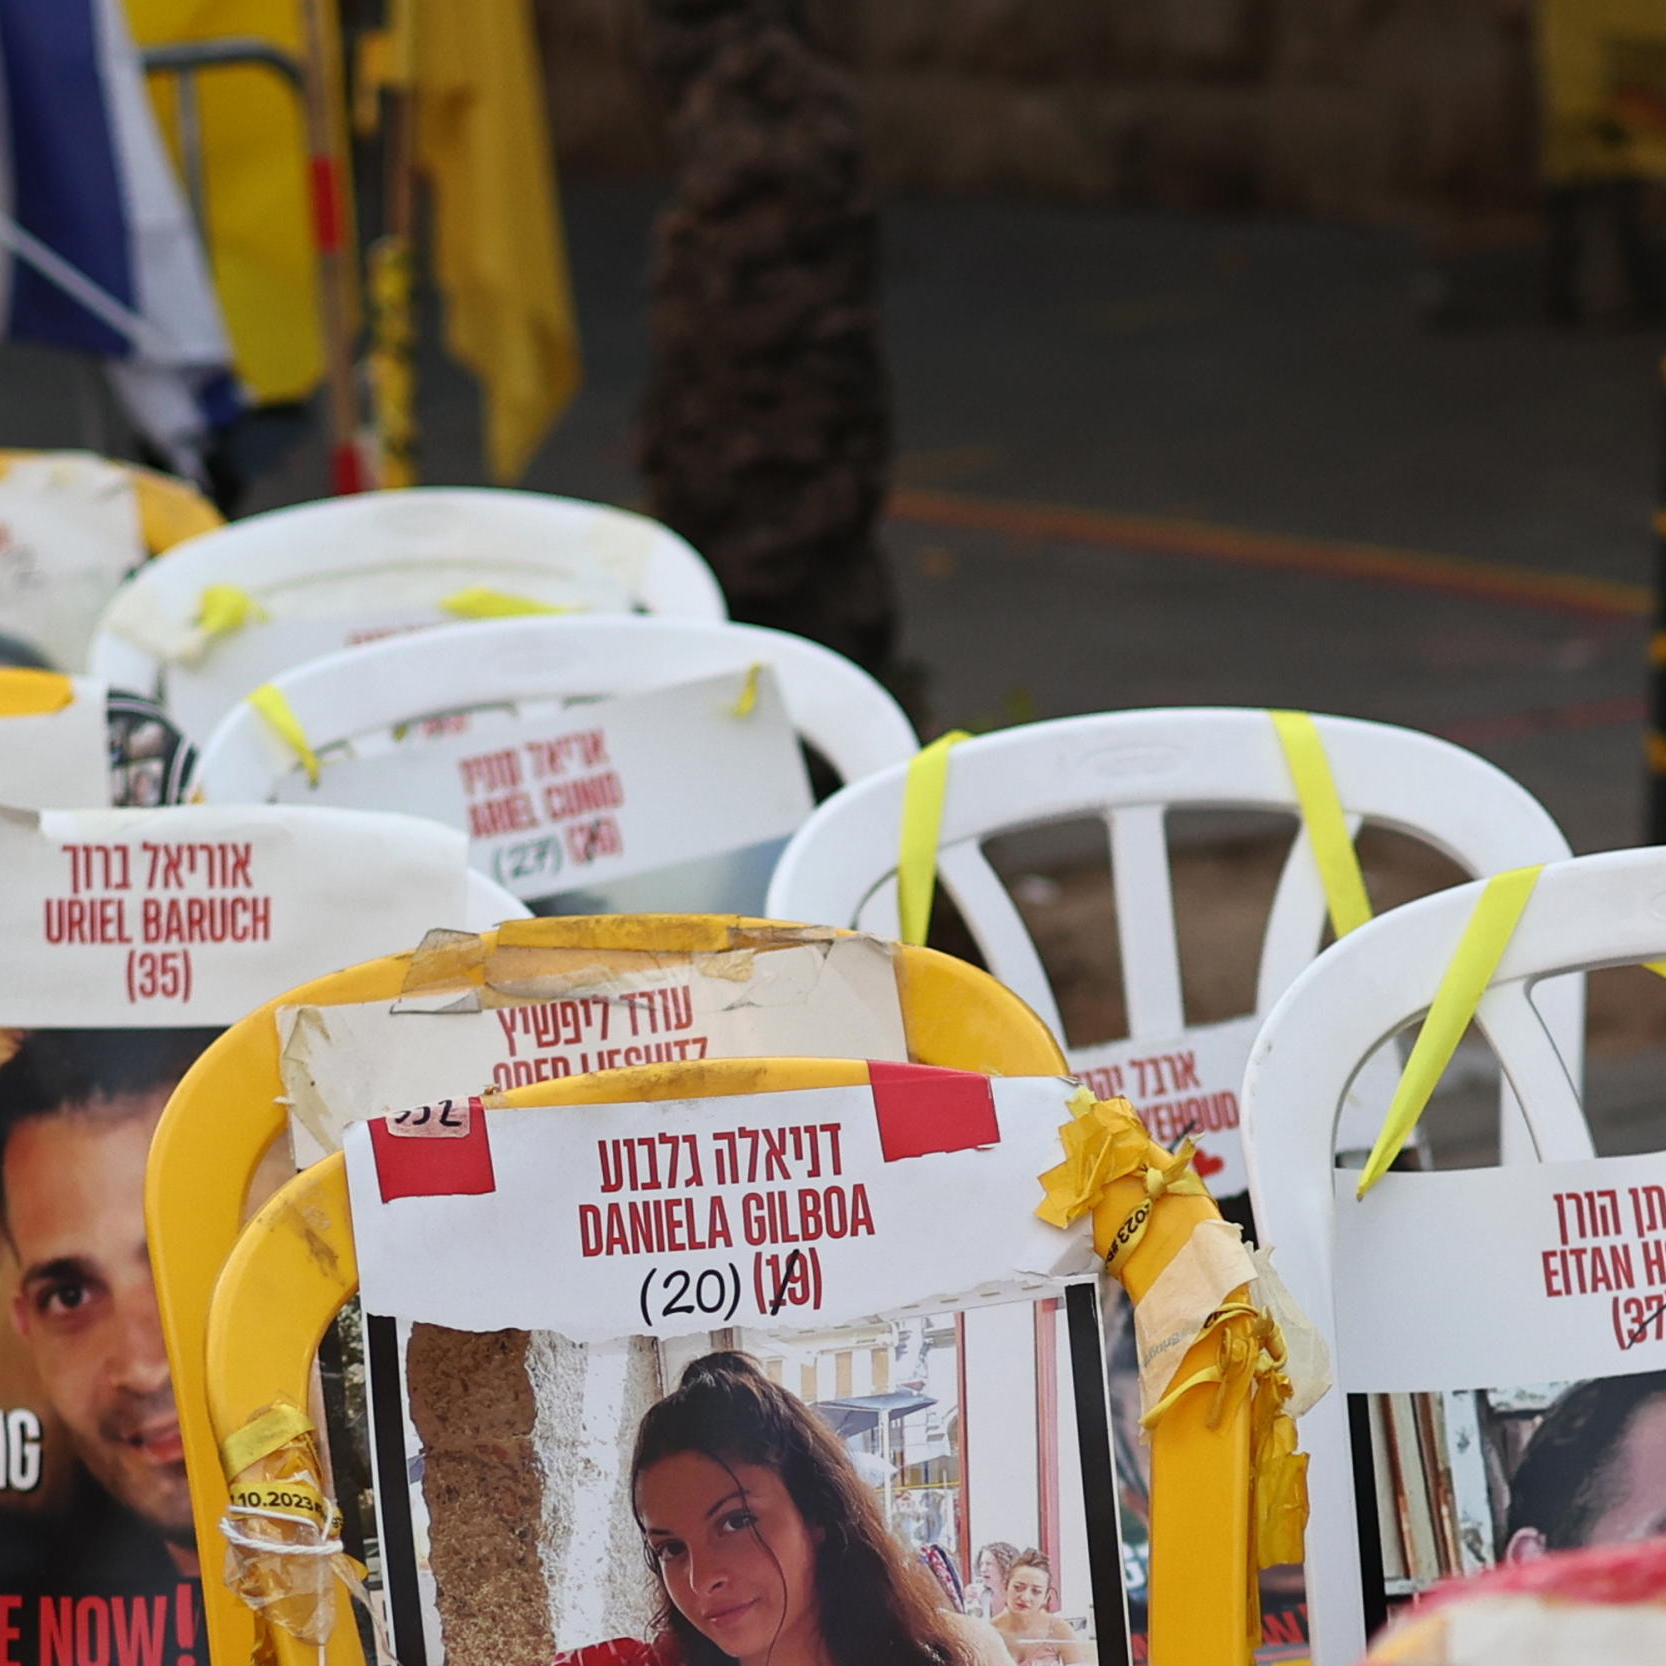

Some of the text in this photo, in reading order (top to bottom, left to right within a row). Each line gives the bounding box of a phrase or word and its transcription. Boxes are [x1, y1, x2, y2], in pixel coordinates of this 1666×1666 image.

[62, 840, 252, 893] אוריאל ברוך
[45, 896, 271, 945] URIEL BARUCH
[126, 949, 192, 1001] (35)
[496, 993, 609, 1057] ליפשיץ
[619, 985, 694, 1036] עודד
[598, 1122, 842, 1194] דניאלה גלבוע
[578, 1184, 875, 1258] DANIELA GILBOA
[1553, 1188, 1622, 1246] הורן
[639, 1263, 741, 1327] (20)
[1542, 1243, 1635, 1298] EITAN
